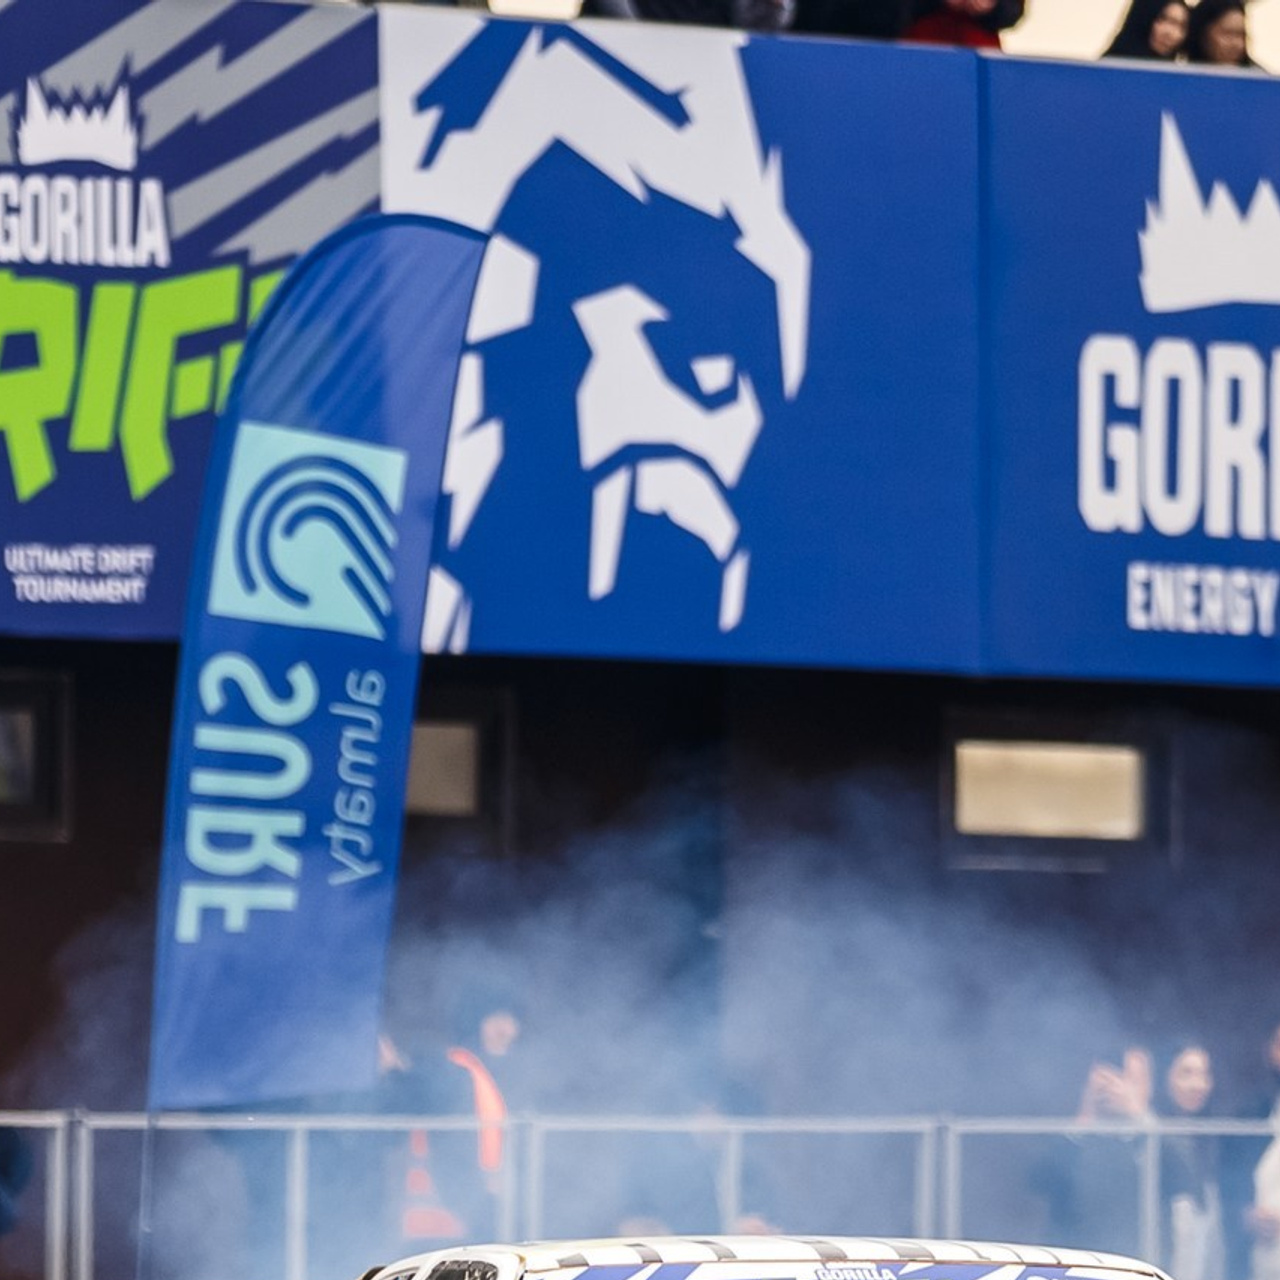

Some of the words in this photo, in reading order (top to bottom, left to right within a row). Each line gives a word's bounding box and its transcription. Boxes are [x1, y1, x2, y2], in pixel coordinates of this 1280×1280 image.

[0, 173, 171, 268] GORILLA
[4, 543, 96, 575] ULTIMATE
[97, 544, 155, 575] DRIFT
[13, 575, 147, 604] TOURNAMENT
[1126, 561, 1280, 638] ENERGY
